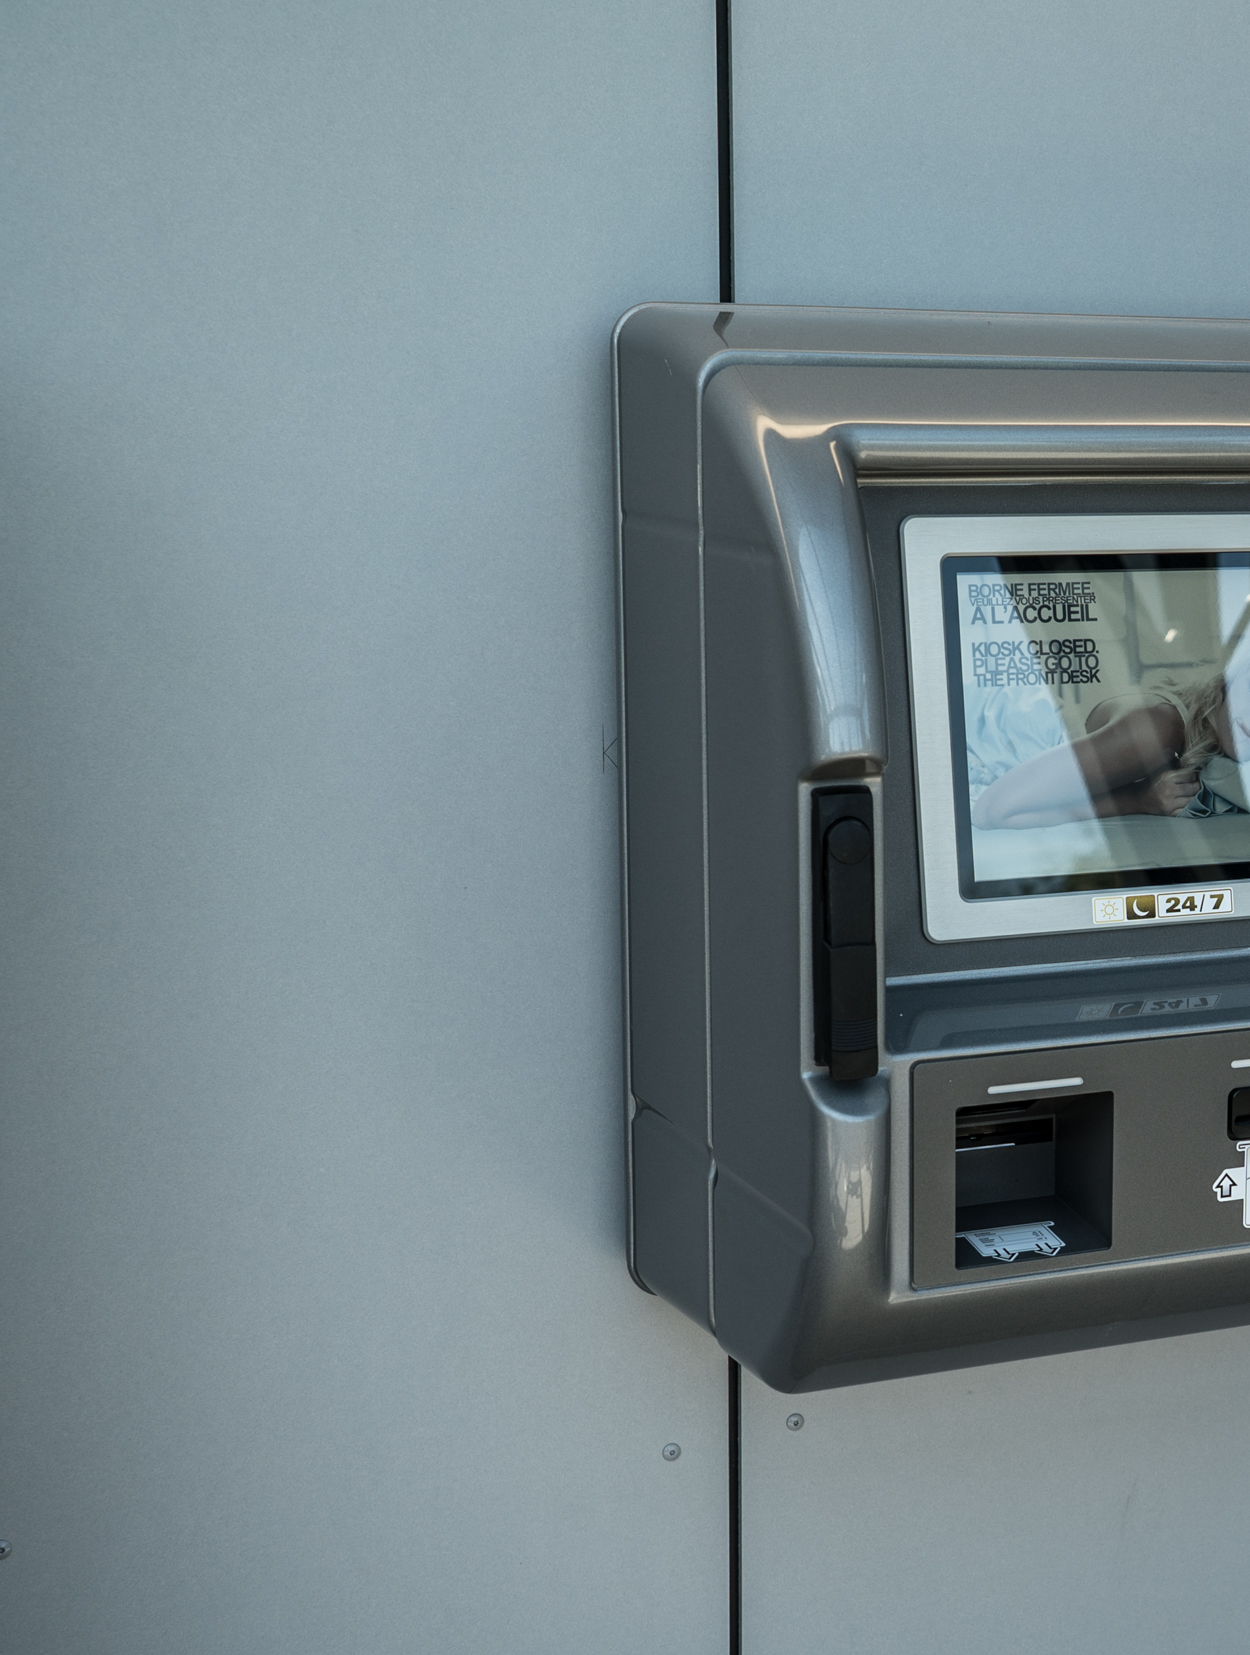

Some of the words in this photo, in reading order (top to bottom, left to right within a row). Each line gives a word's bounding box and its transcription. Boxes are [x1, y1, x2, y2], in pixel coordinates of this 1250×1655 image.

[968, 583, 1025, 598] BORNE
[1028, 582, 1095, 597] FERMEE.
[970, 597, 1014, 607] VEUILLEZ
[1014, 597, 1040, 605] VOUS
[1042, 596, 1096, 605] PRESENTER
[971, 606, 987, 625] A
[972, 641, 1025, 658] KIOSK
[1027, 639, 1099, 656] CLOSED.
[973, 656, 1041, 673] PLEASE
[1044, 655, 1072, 671] GO
[1073, 654, 1099, 670] TO
[974, 672, 1004, 687] THE
[1007, 671, 1056, 686] FRONT
[1060, 669, 1101, 684] DESK
[1165, 893, 1224, 913] 24/7
